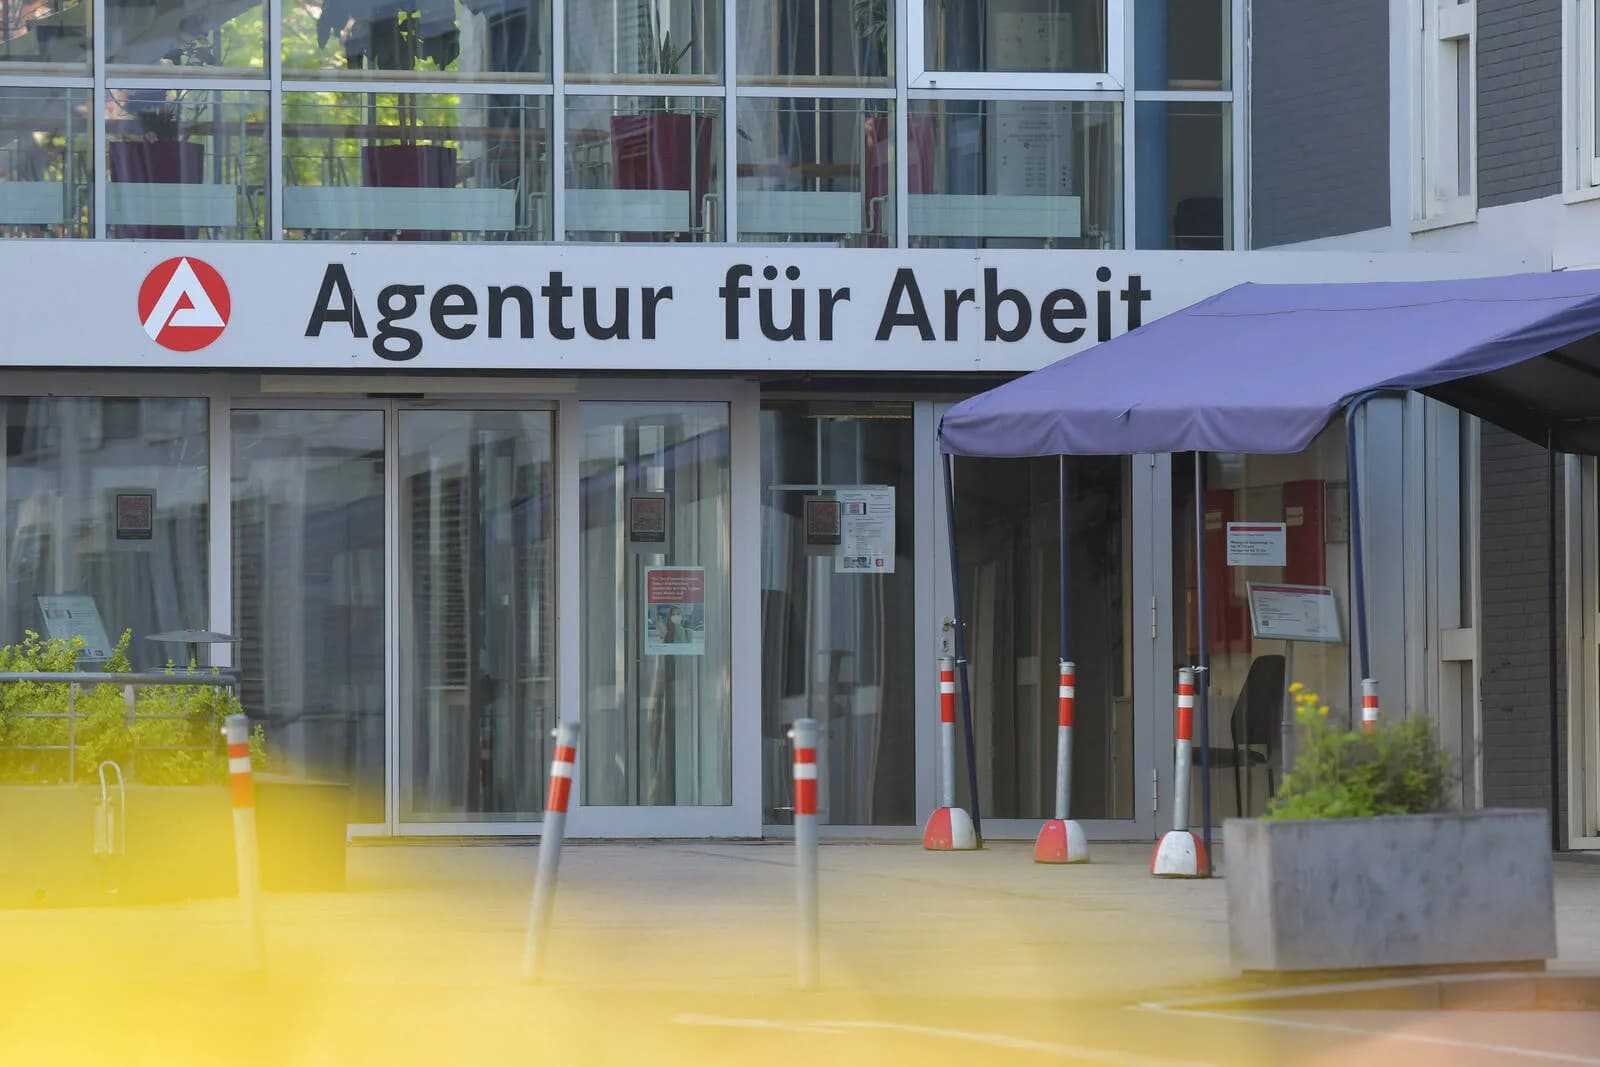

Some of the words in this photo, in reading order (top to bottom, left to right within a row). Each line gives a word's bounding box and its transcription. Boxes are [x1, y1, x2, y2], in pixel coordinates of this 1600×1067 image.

[304, 263, 674, 362] Agentur
[718, 264, 851, 342] für
[874, 266, 1152, 344] Arbeit
